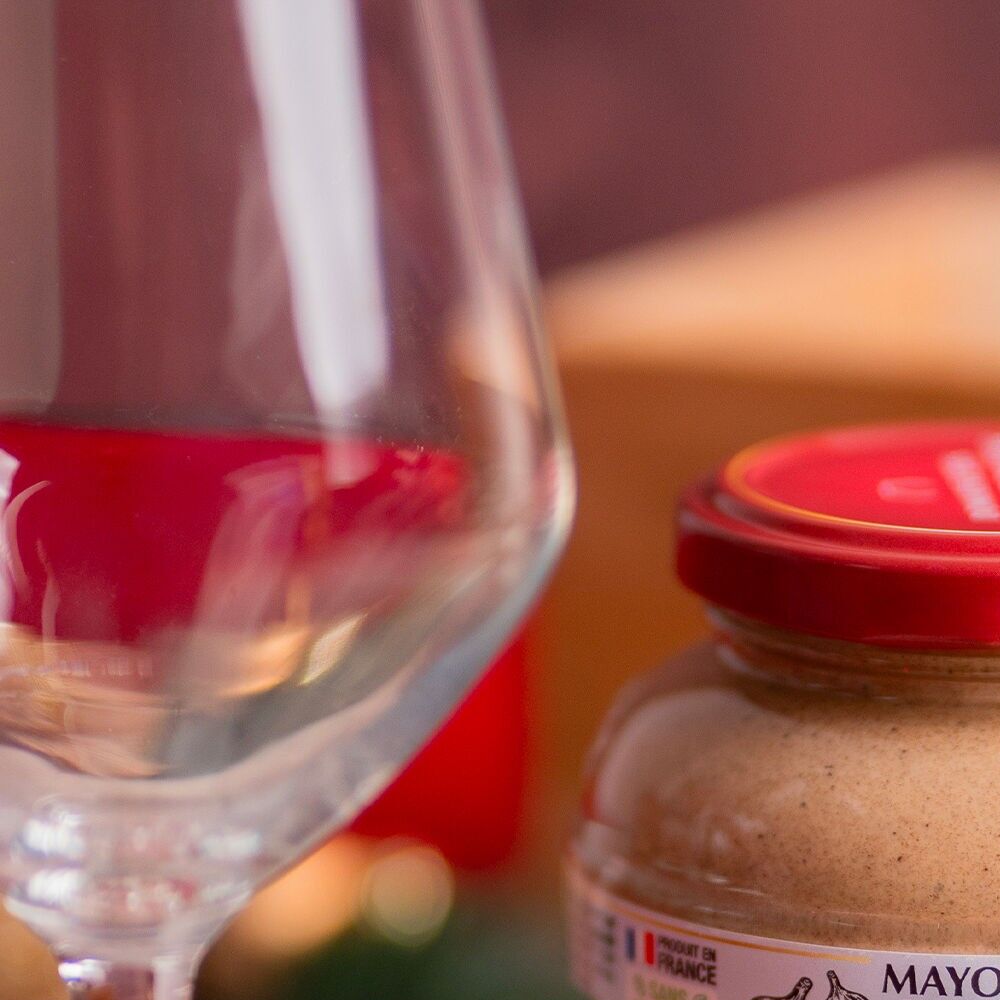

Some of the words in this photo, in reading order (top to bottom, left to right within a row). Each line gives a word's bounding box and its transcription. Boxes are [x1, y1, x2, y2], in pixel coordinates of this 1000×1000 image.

[658, 935, 700, 959] PRODUIT
[702, 946, 717, 962] EN
[658, 951, 717, 986] FRANCE
